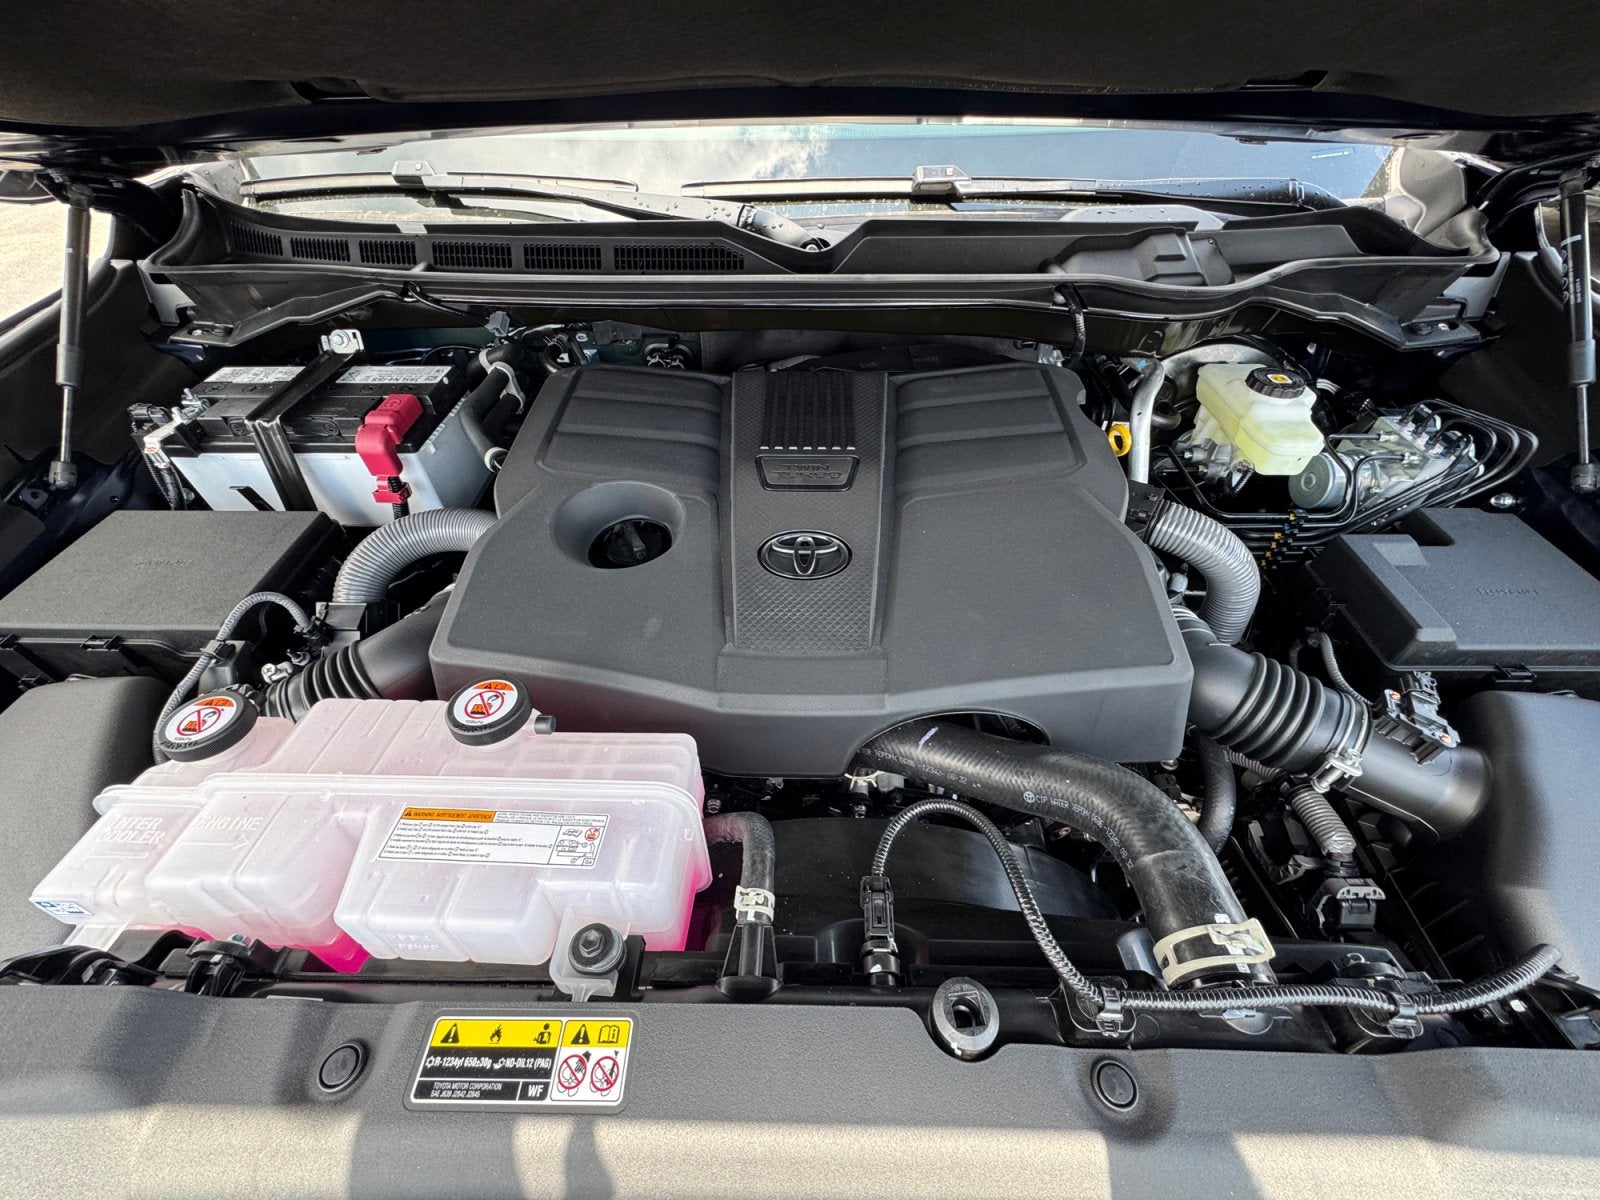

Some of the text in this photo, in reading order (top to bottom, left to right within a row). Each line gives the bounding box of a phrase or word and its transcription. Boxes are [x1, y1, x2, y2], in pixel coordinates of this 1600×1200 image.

[534, 1057, 551, 1069] (PAG)
[433, 1082, 502, 1091] TOYOTA MOTOR CORPORATION
[528, 1084, 544, 1097] WF
[430, 1090, 440, 1098] SAE
